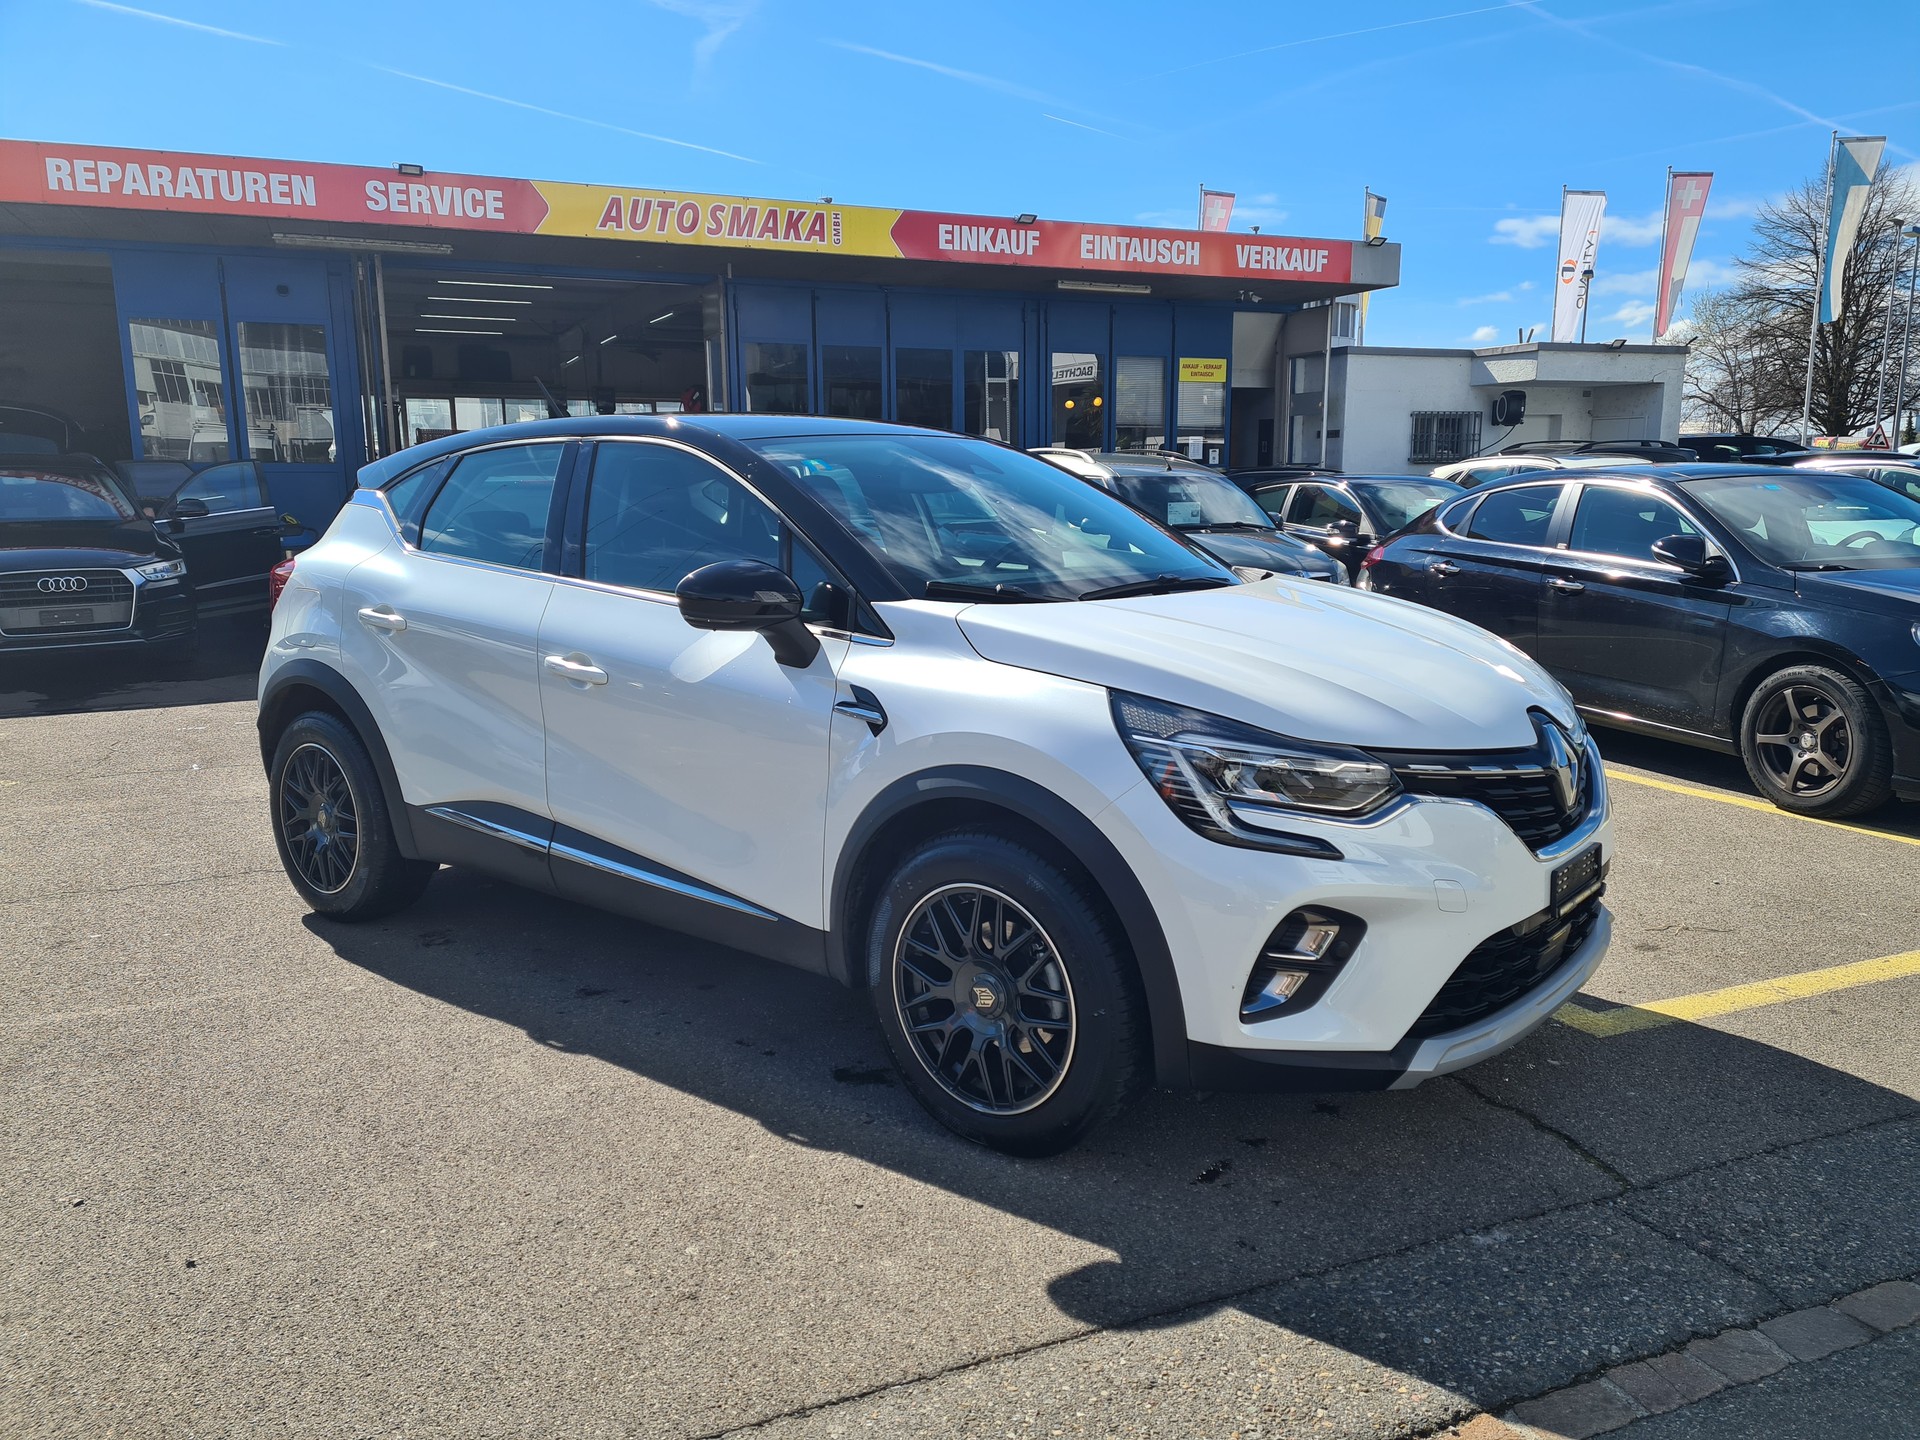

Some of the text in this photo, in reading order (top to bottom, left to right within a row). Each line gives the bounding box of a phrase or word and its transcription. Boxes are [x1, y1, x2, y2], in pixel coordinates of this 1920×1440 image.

[45, 157, 316, 206] REPARATUREN
[364, 180, 505, 220] SERVICE
[596, 195, 827, 245] AUTO SMAKA
[832, 212, 841, 245] GMBH
[938, 224, 1041, 256] EINKAUF
[1080, 233, 1201, 266] EINTAUSCH
[1236, 244, 1329, 274] VERKAUF
